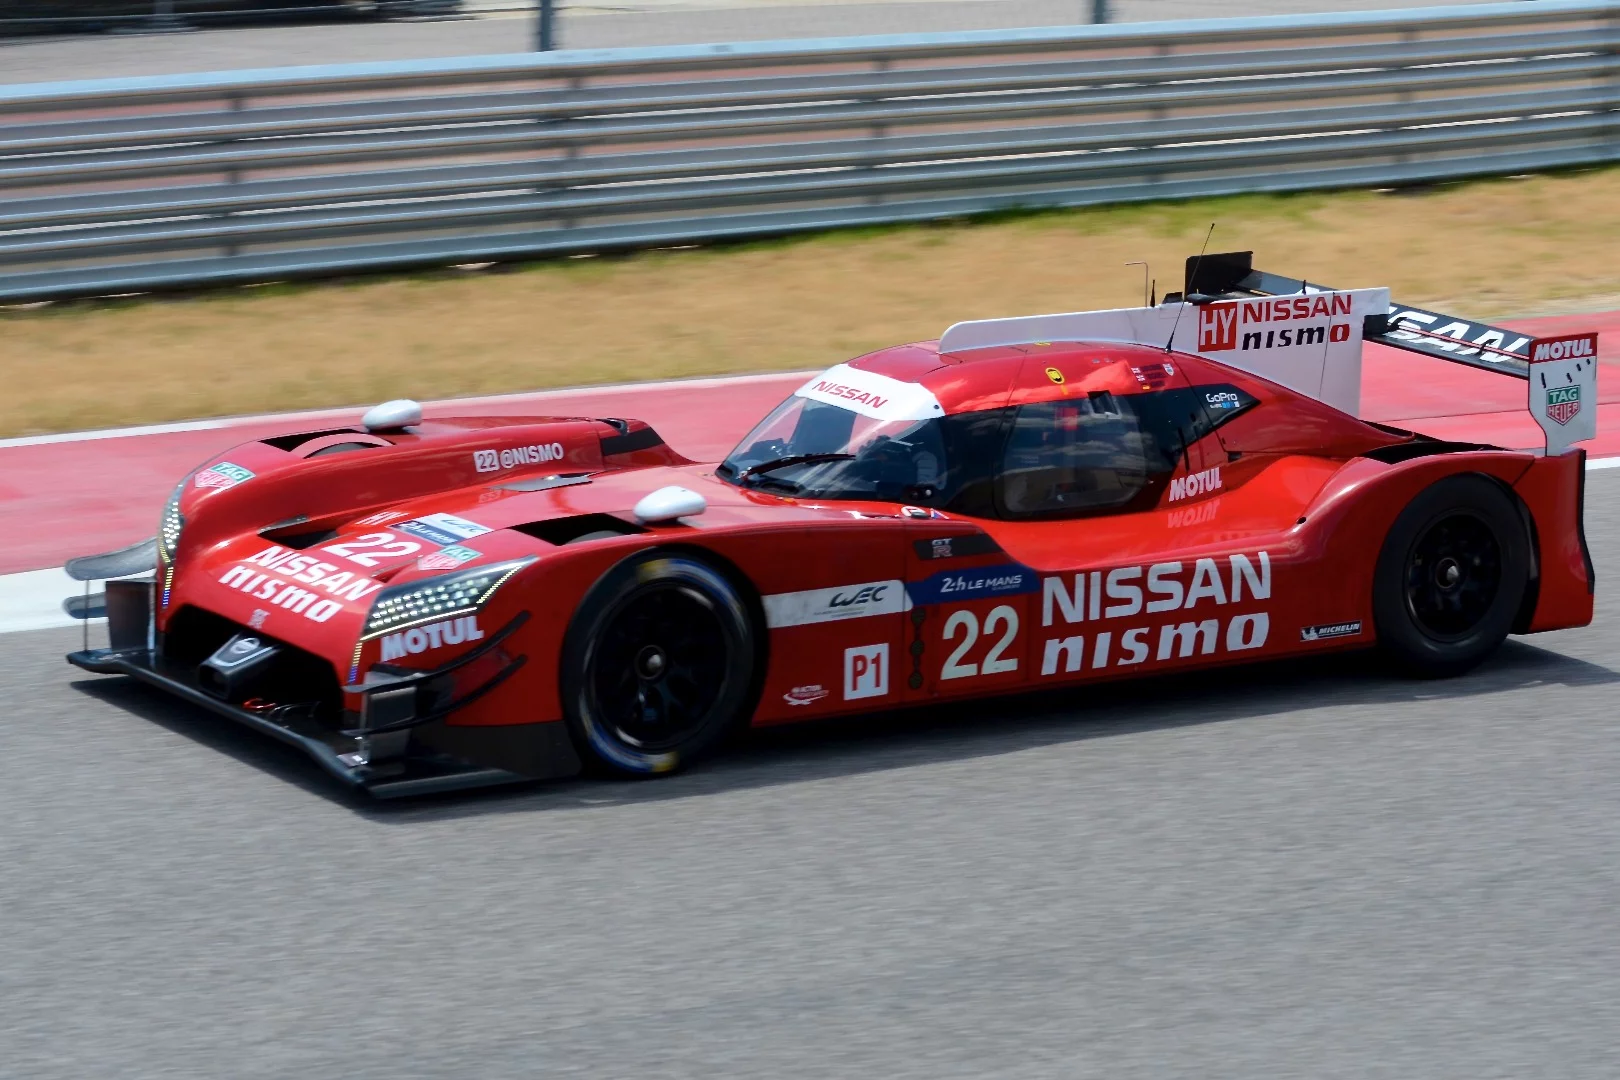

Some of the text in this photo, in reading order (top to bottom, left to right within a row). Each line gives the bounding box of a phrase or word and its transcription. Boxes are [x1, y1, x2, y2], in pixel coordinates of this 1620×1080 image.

[1243, 294, 1351, 324] NISSAN
[1200, 308, 1236, 346] HY
[1533, 339, 1592, 361] MOTUL
[812, 380, 888, 409] NISSAN
[1205, 392, 1238, 403] GoPro
[1549, 388, 1578, 404] TAG
[1548, 402, 1578, 421] HEUER
[477, 443, 564, 469] 22 @NISMO
[215, 463, 249, 481] TAG
[1169, 467, 1223, 502] MOTUL
[321, 532, 423, 567] 22
[244, 545, 385, 601] NISSAN
[967, 579, 984, 590] LE
[985, 574, 1022, 588] MANS
[829, 585, 888, 608] WEC
[1042, 551, 1271, 626] NISSAN
[380, 616, 485, 663] MOTUL
[940, 605, 1019, 681] 22
[1318, 623, 1360, 635] MICHELIN
[852, 652, 882, 692] P1
